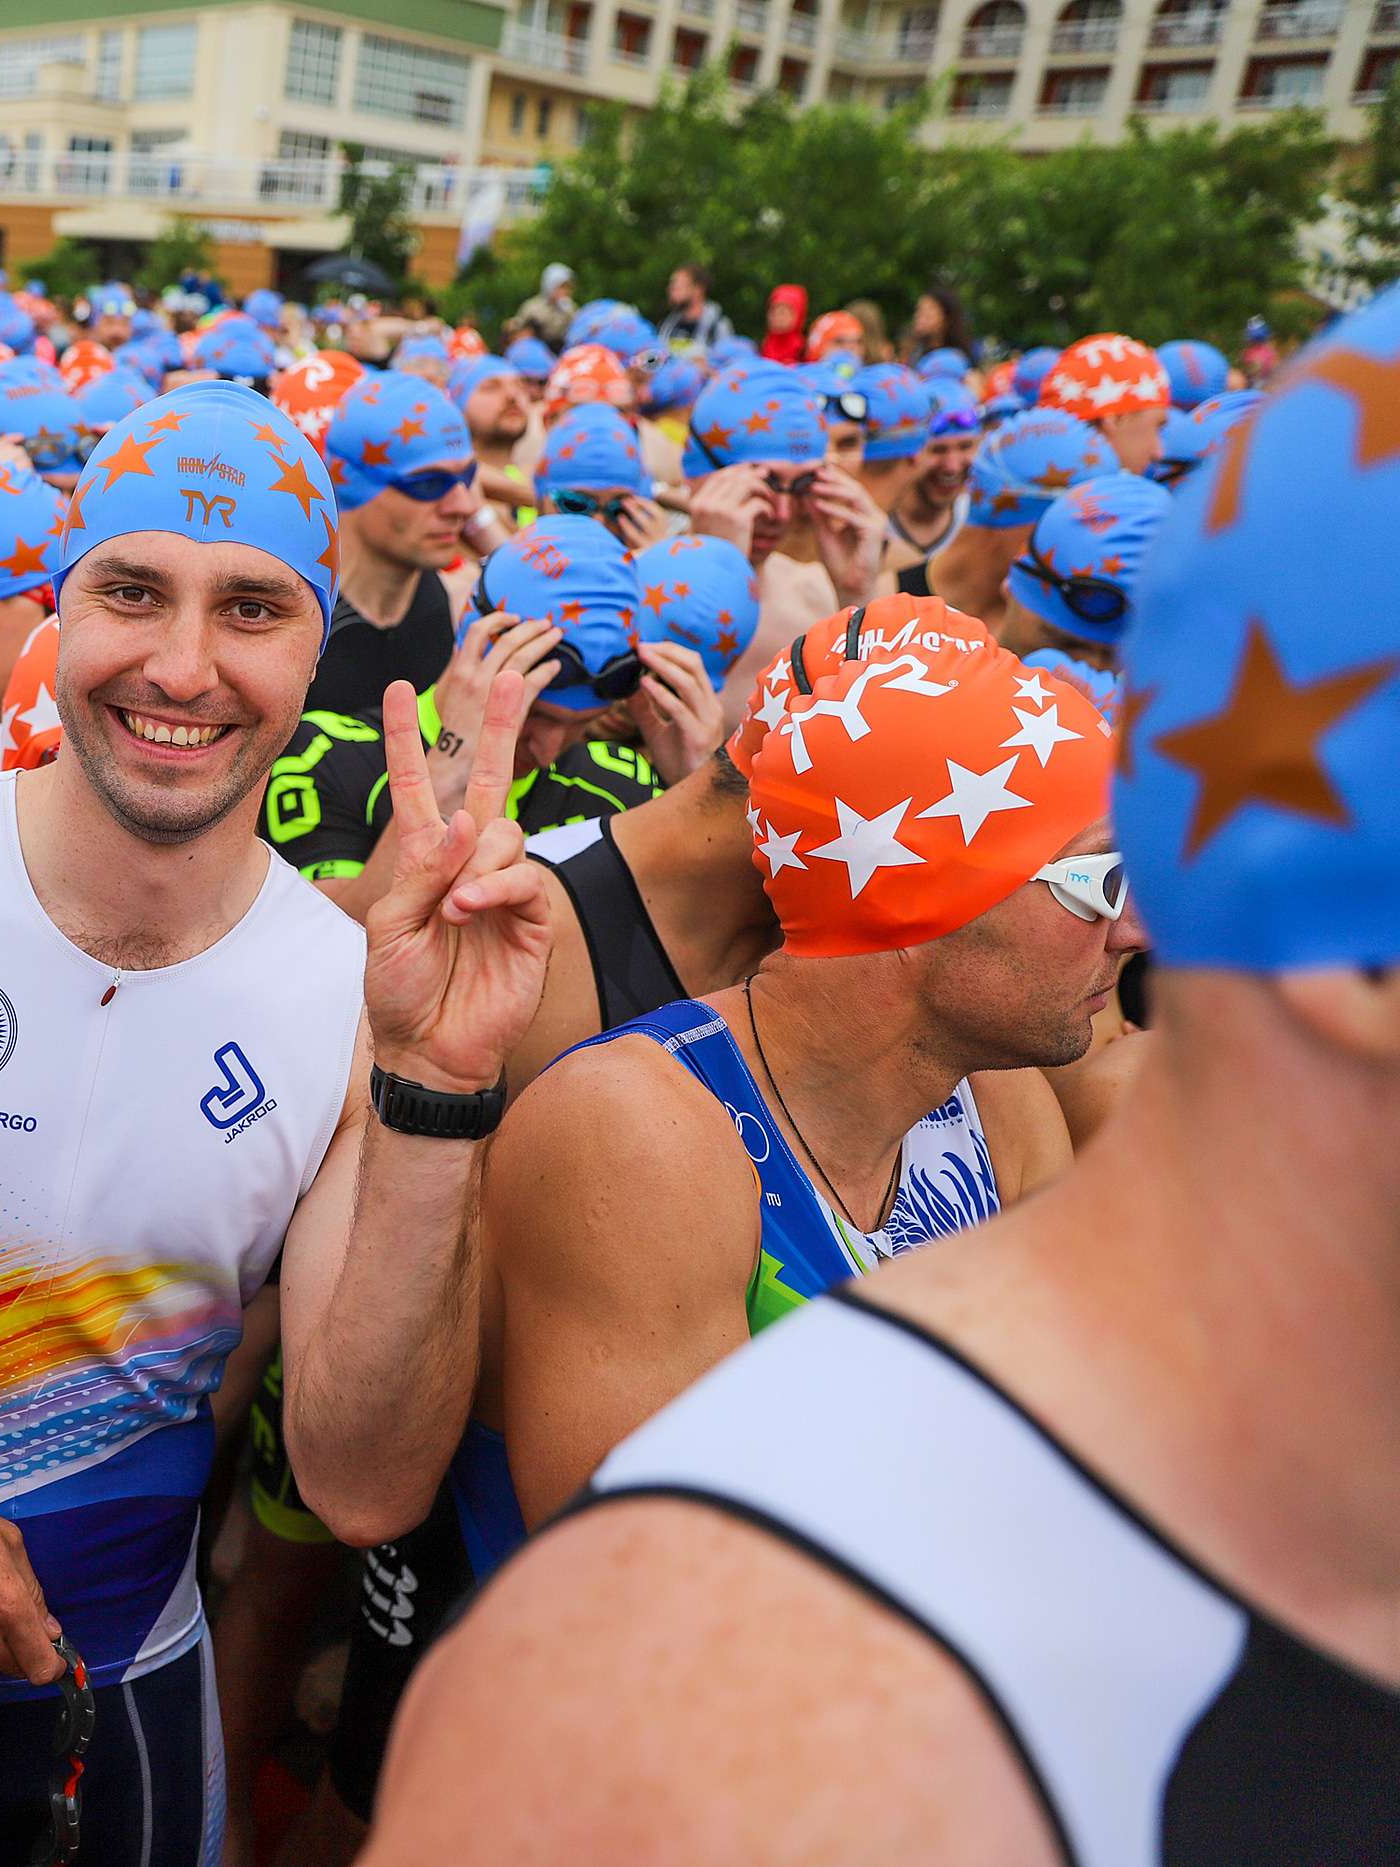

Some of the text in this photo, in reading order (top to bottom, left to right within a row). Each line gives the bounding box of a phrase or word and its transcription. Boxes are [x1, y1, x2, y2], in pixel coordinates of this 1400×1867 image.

[180, 489, 236, 528] TYR
[1069, 872, 1090, 884] TYR
[224, 1098, 278, 1144] JAKROO
